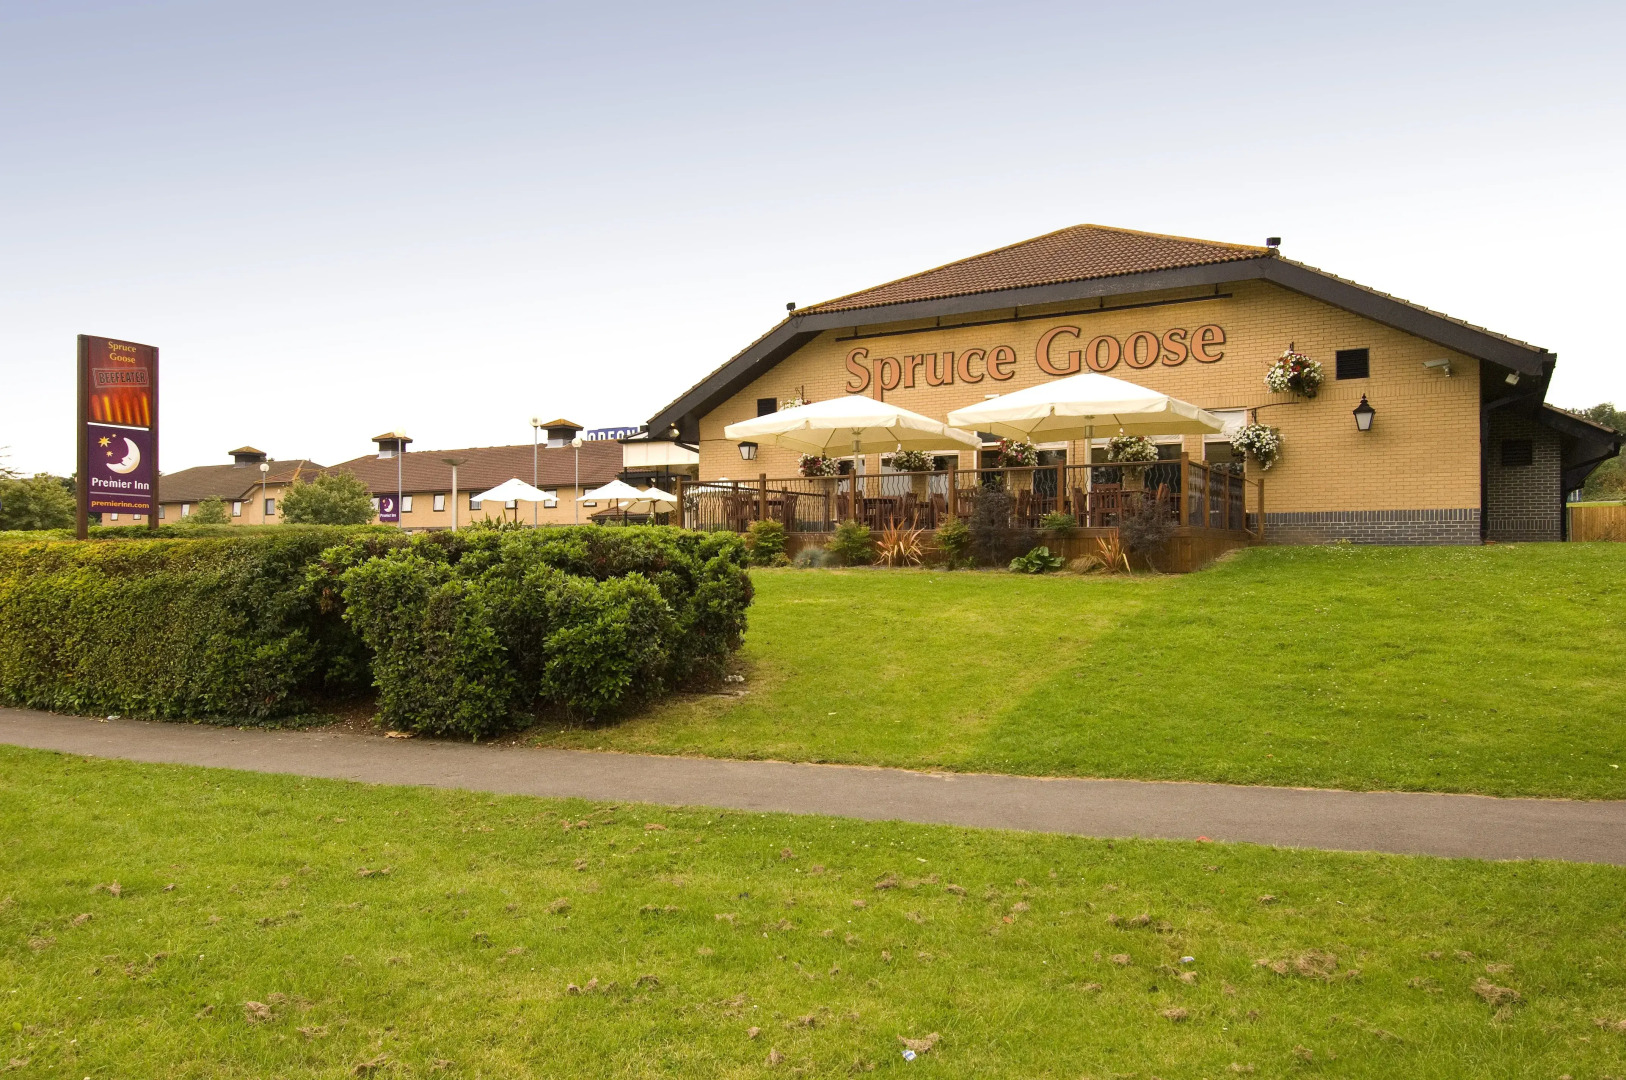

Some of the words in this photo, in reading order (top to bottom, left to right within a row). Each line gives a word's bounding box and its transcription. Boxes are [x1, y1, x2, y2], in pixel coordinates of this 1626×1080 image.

[108, 341, 137, 353] Spruce
[109, 352, 136, 364] Goose
[846, 345, 1016, 402] Spruce
[1035, 324, 1226, 376] Goose
[98, 372, 146, 384] BEEFEATER
[91, 477, 132, 489] Premier
[134, 480, 150, 490] Inn
[91, 500, 150, 509] premierinn.com
